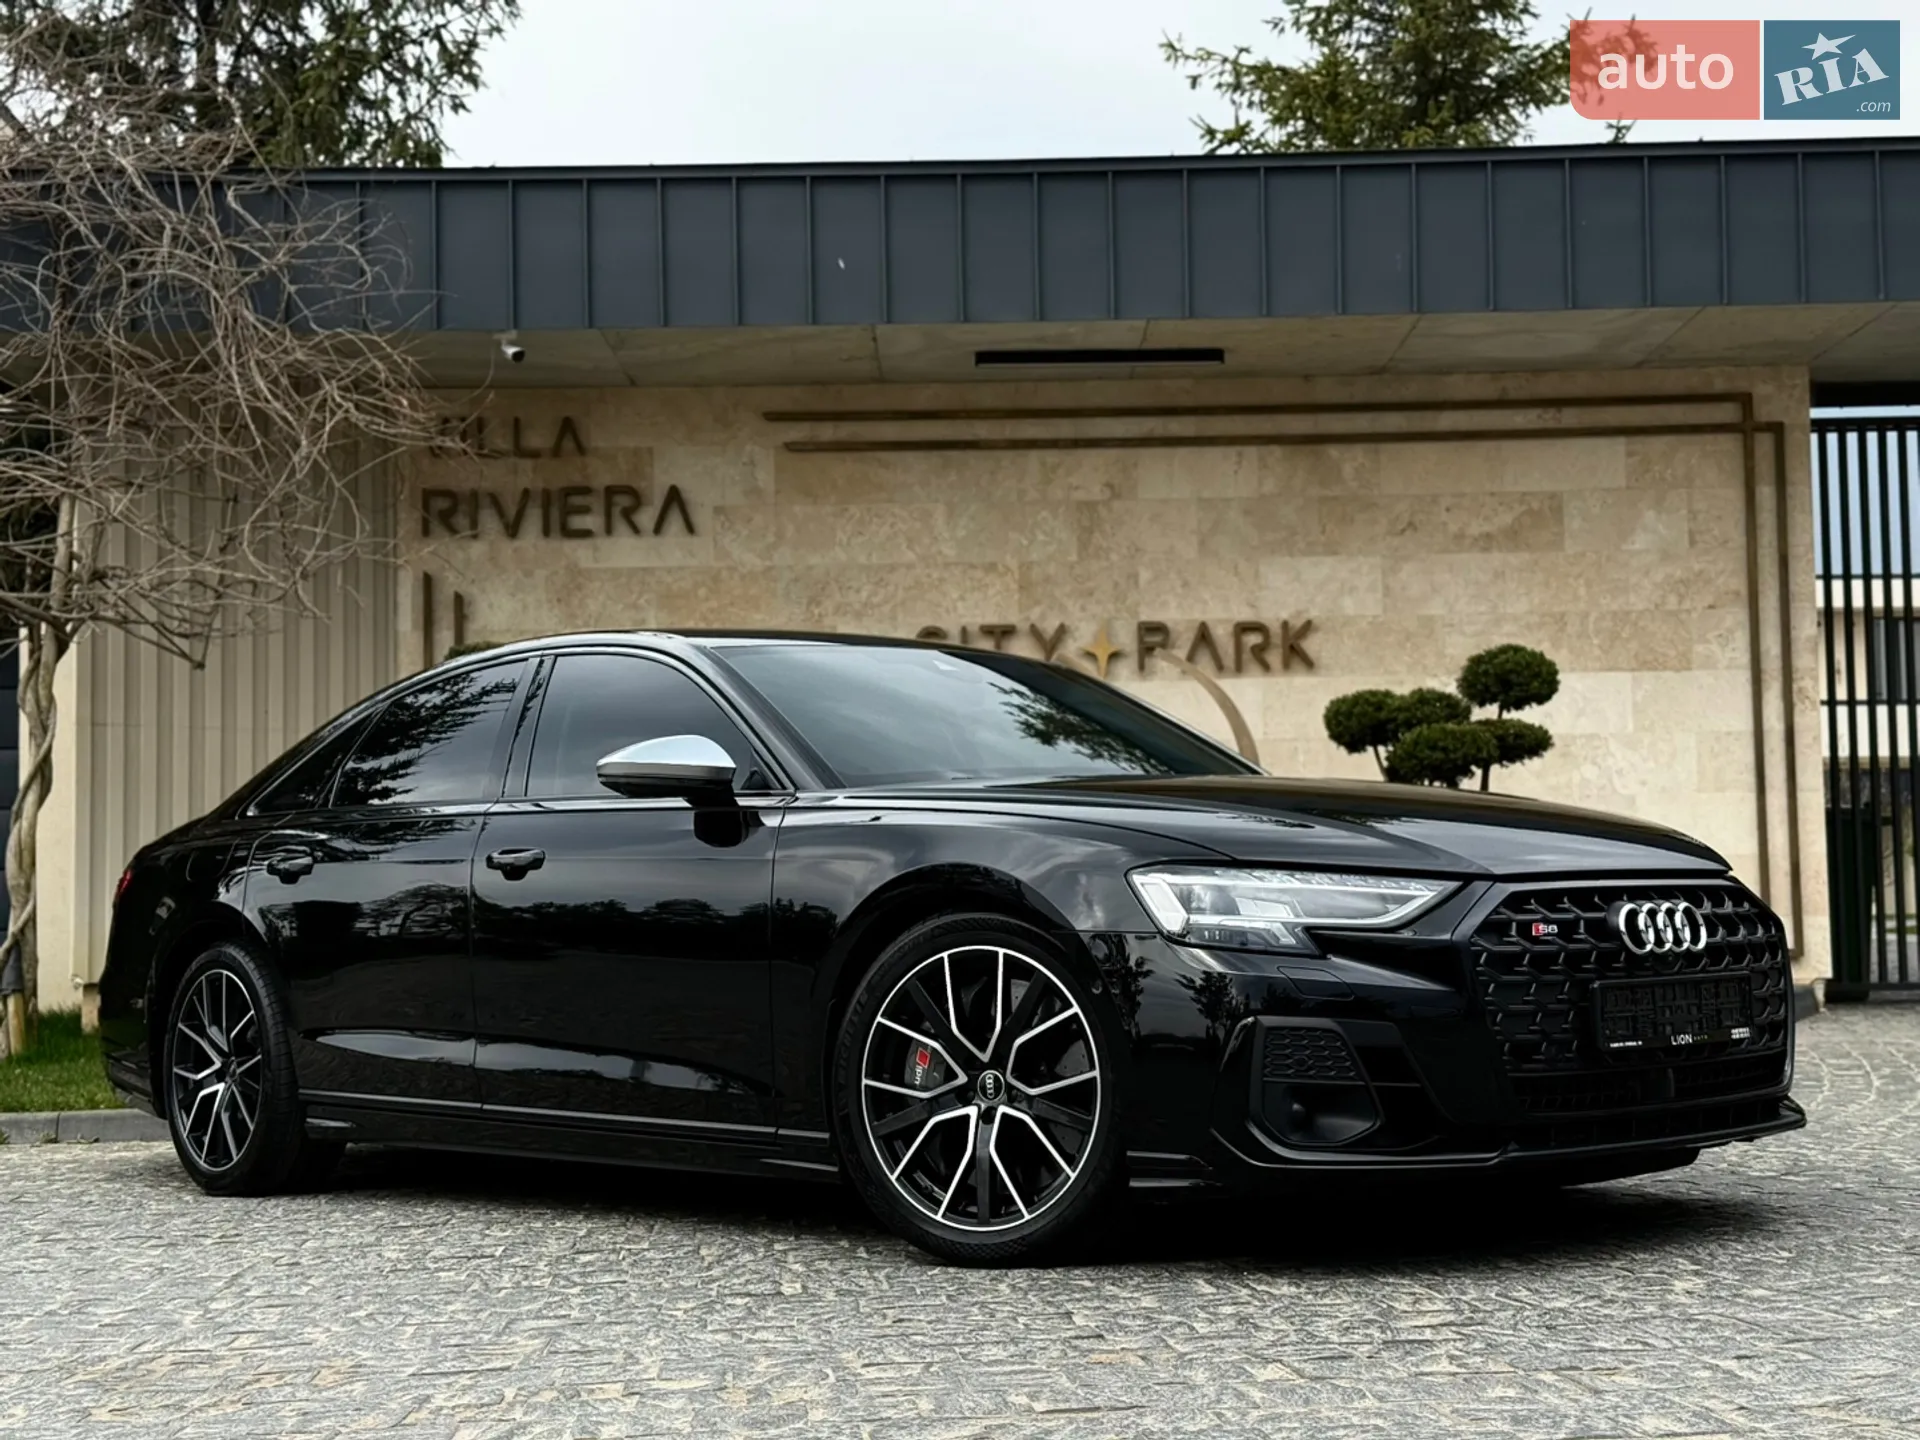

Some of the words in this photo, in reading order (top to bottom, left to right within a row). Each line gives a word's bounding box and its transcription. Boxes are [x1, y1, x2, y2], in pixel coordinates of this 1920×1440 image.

[421, 484, 696, 539] RIVIERA
[1137, 619, 1316, 674] PARK
[1670, 1033, 1693, 1046] LION
